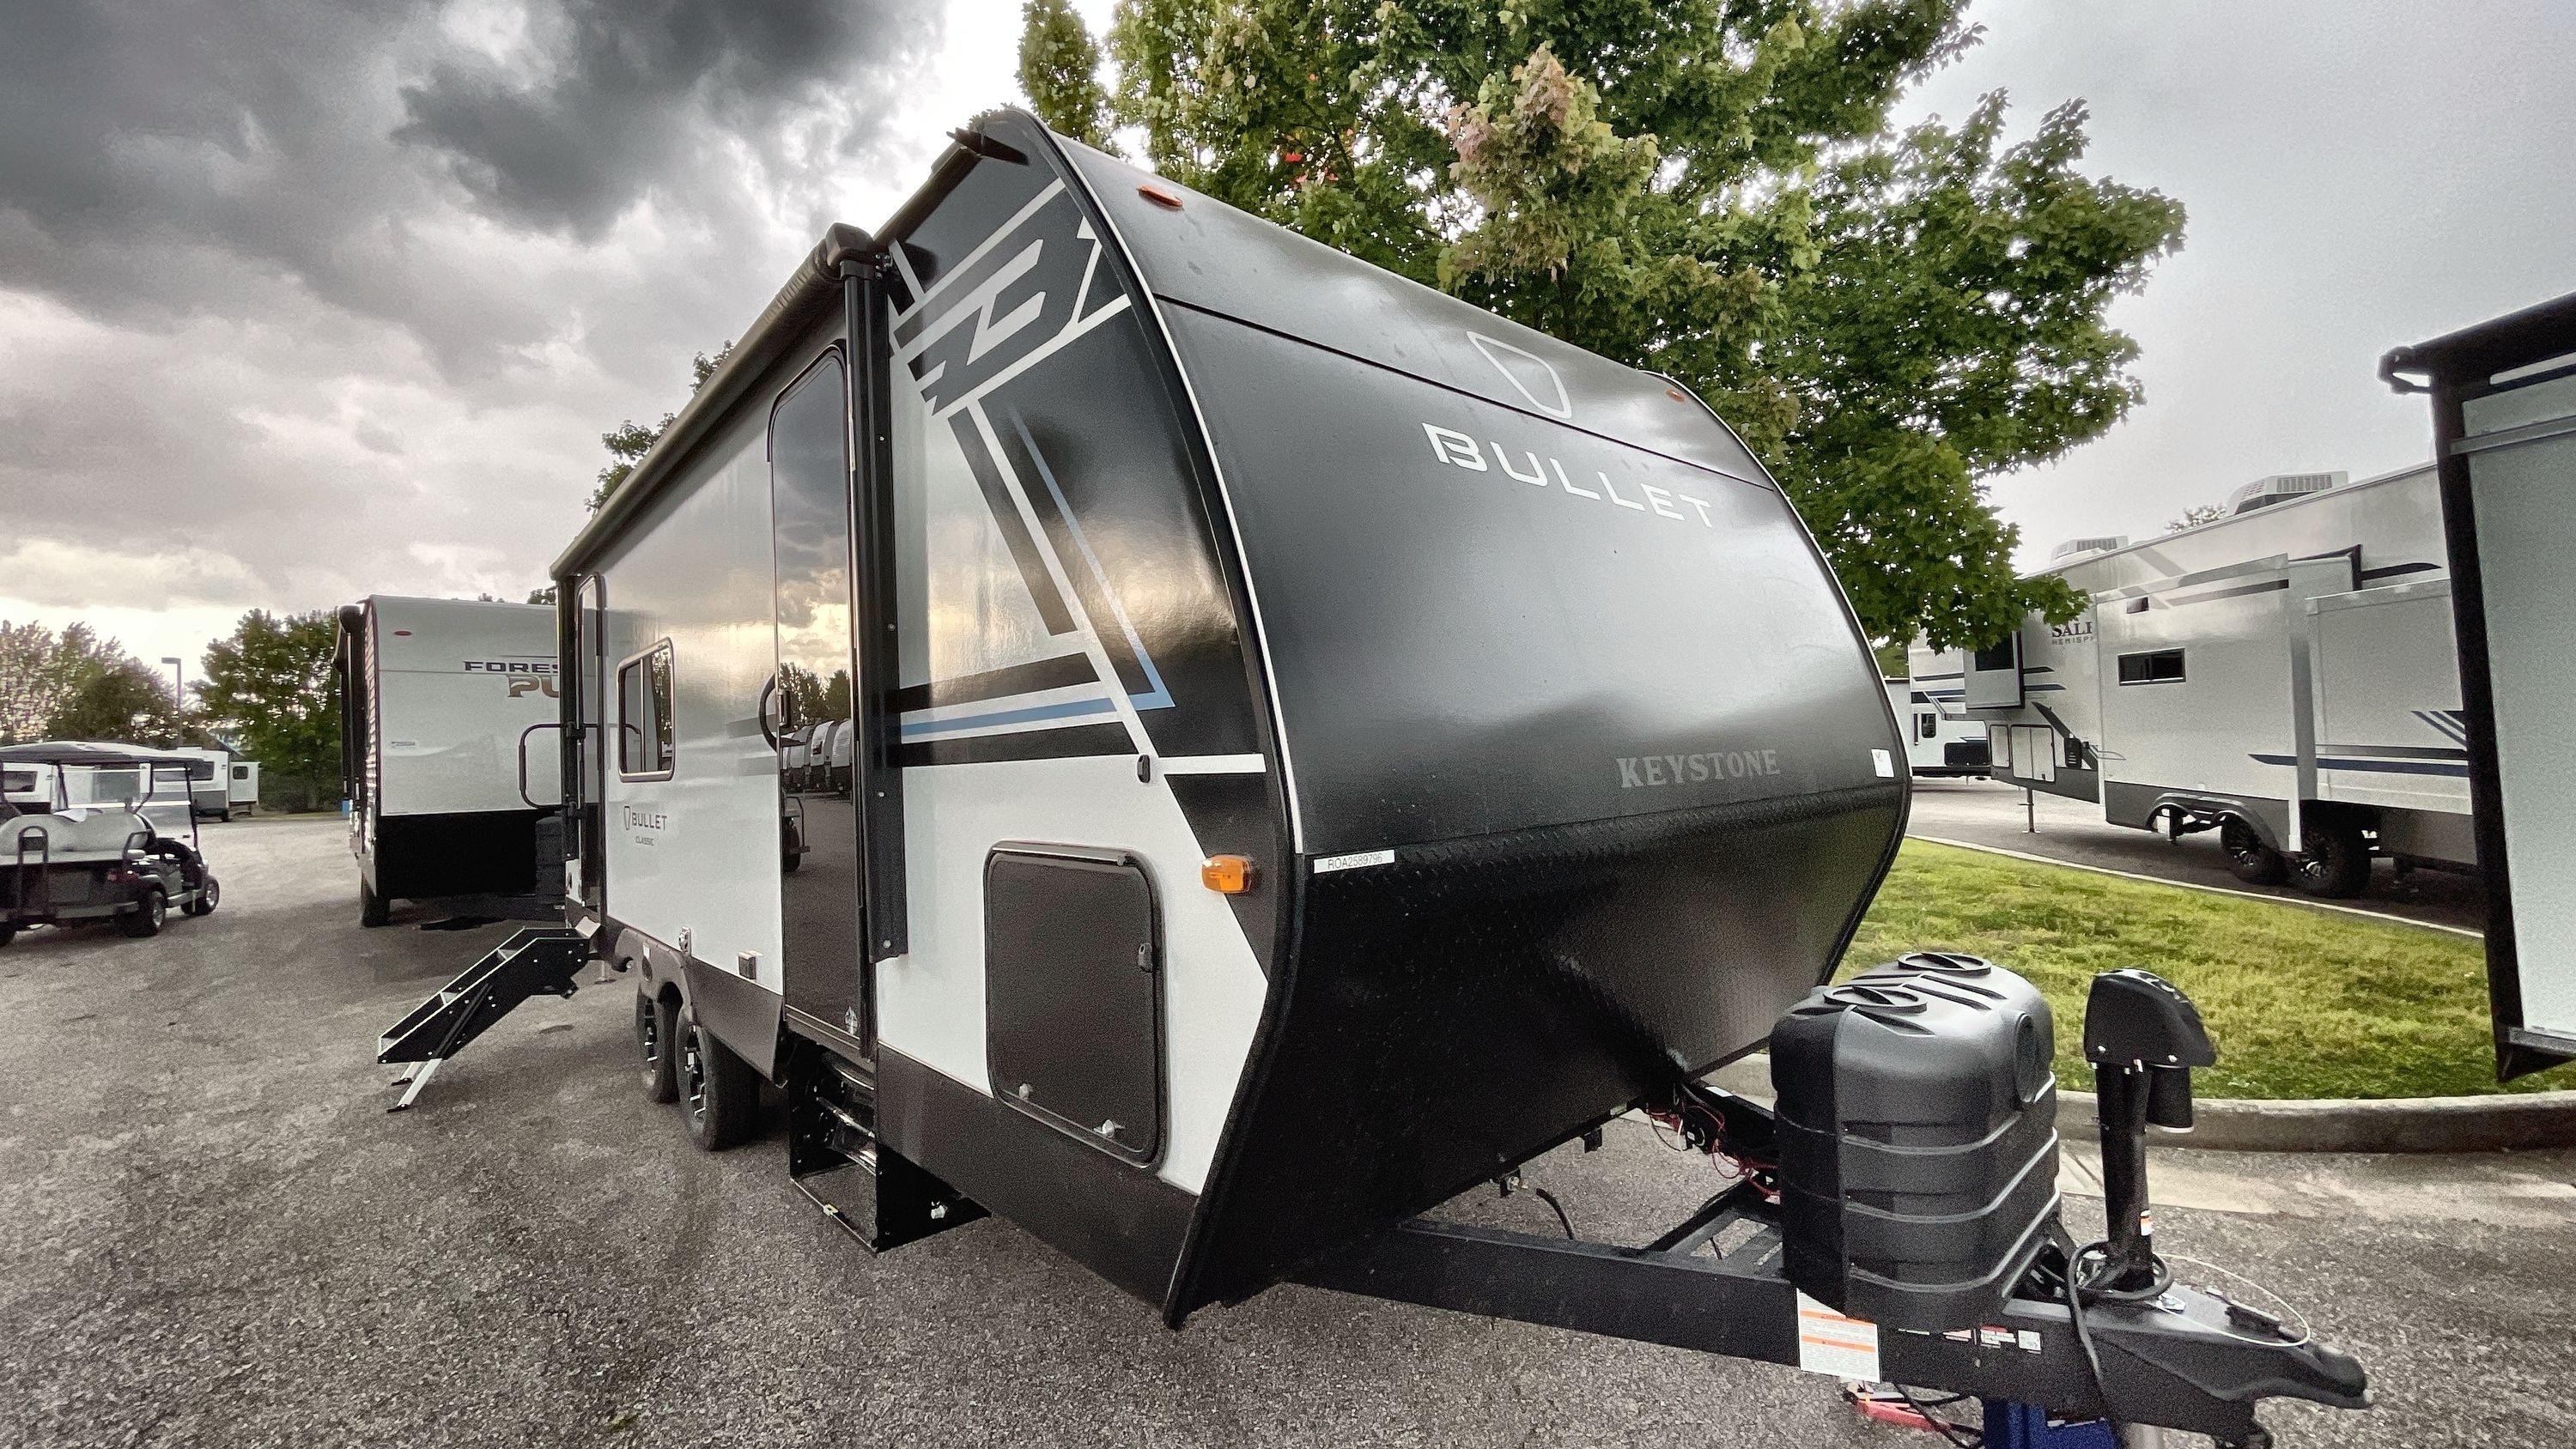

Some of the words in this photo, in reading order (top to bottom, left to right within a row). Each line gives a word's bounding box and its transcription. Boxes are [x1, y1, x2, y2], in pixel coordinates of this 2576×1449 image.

[1421, 422, 1712, 528] BULLET
[1615, 749, 1781, 788] KEYSTONE
[631, 812, 668, 831] BULLET
